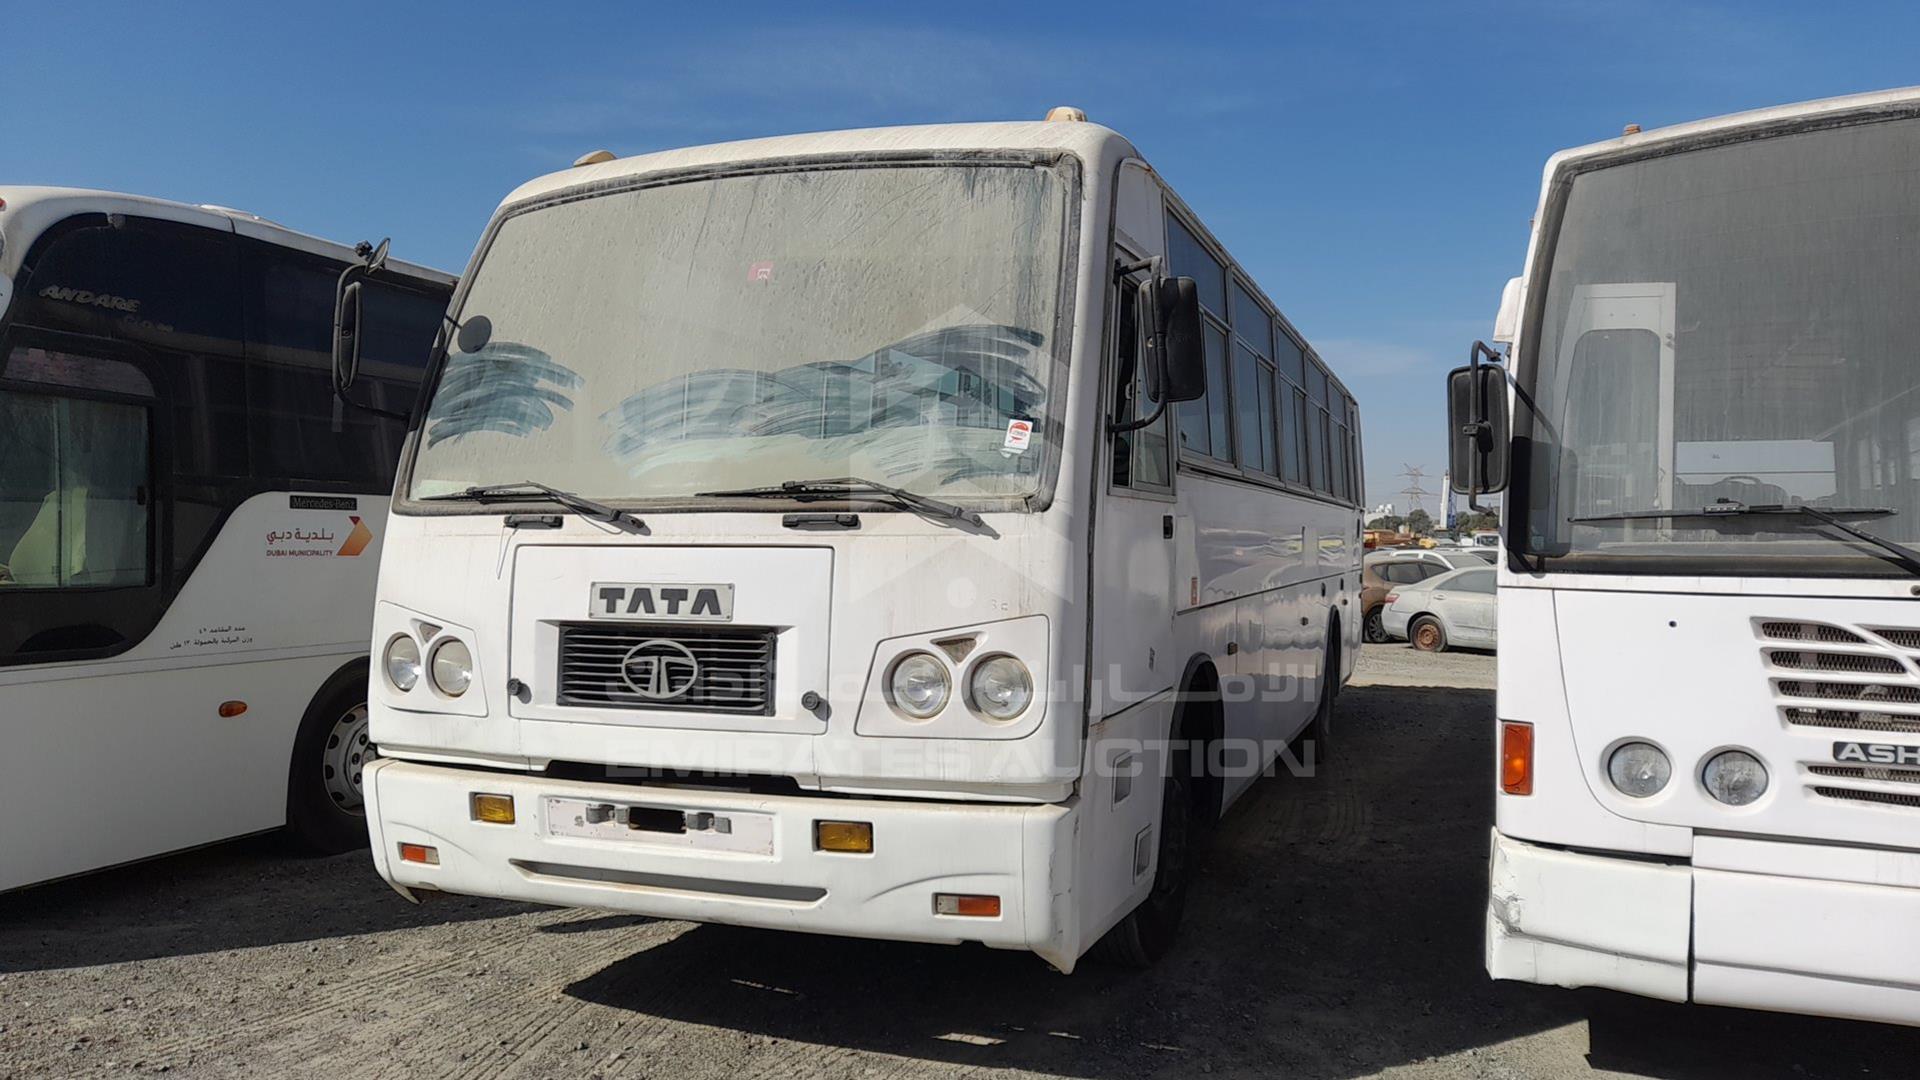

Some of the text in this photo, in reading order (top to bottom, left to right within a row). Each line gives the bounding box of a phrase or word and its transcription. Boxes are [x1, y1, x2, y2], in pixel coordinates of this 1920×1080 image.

[38, 285, 141, 313] ANDARE
[291, 496, 356, 509] Mercedes-Benz
[266, 528, 334, 545] بلدية دبي
[599, 588, 722, 616] TATA
